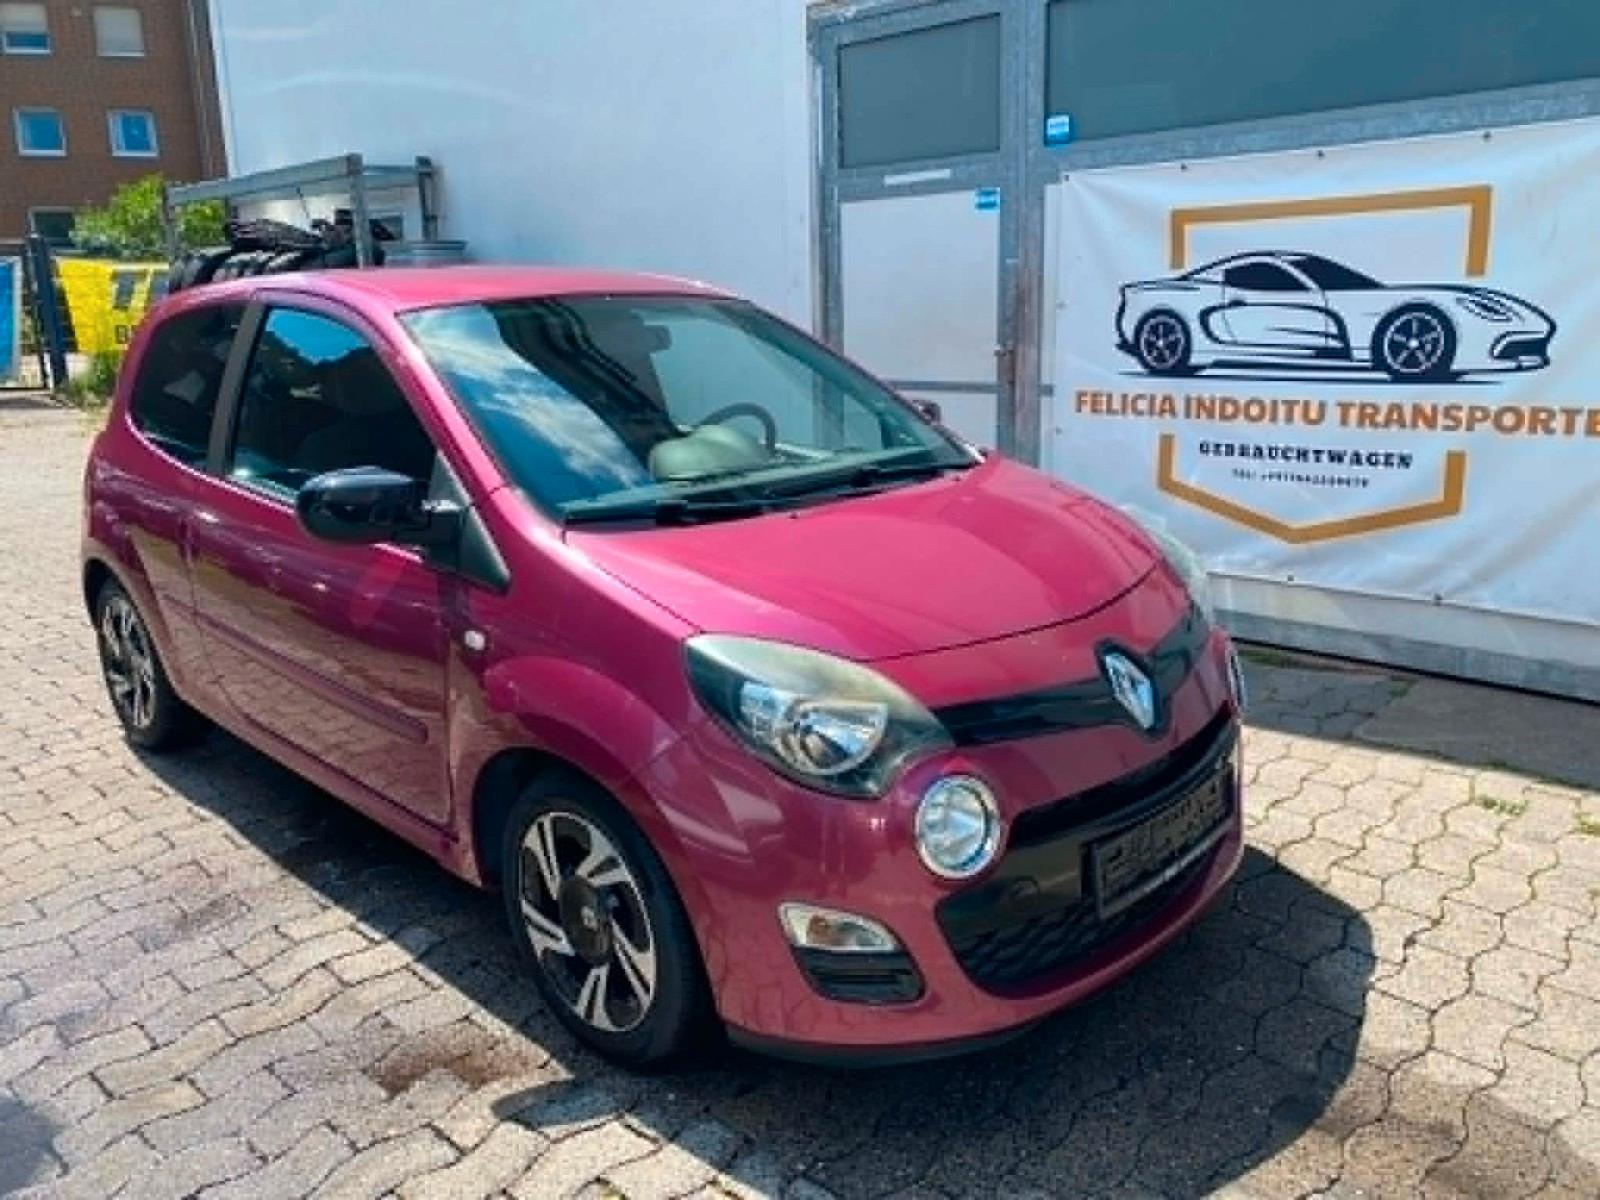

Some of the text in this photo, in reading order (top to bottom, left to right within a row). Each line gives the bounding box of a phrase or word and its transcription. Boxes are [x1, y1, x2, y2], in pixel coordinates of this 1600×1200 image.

[1075, 390, 1600, 438] FELICIA INDOITU TRANSPORTE
[1199, 442, 1413, 469] GEBRAUCHTWAGEN
